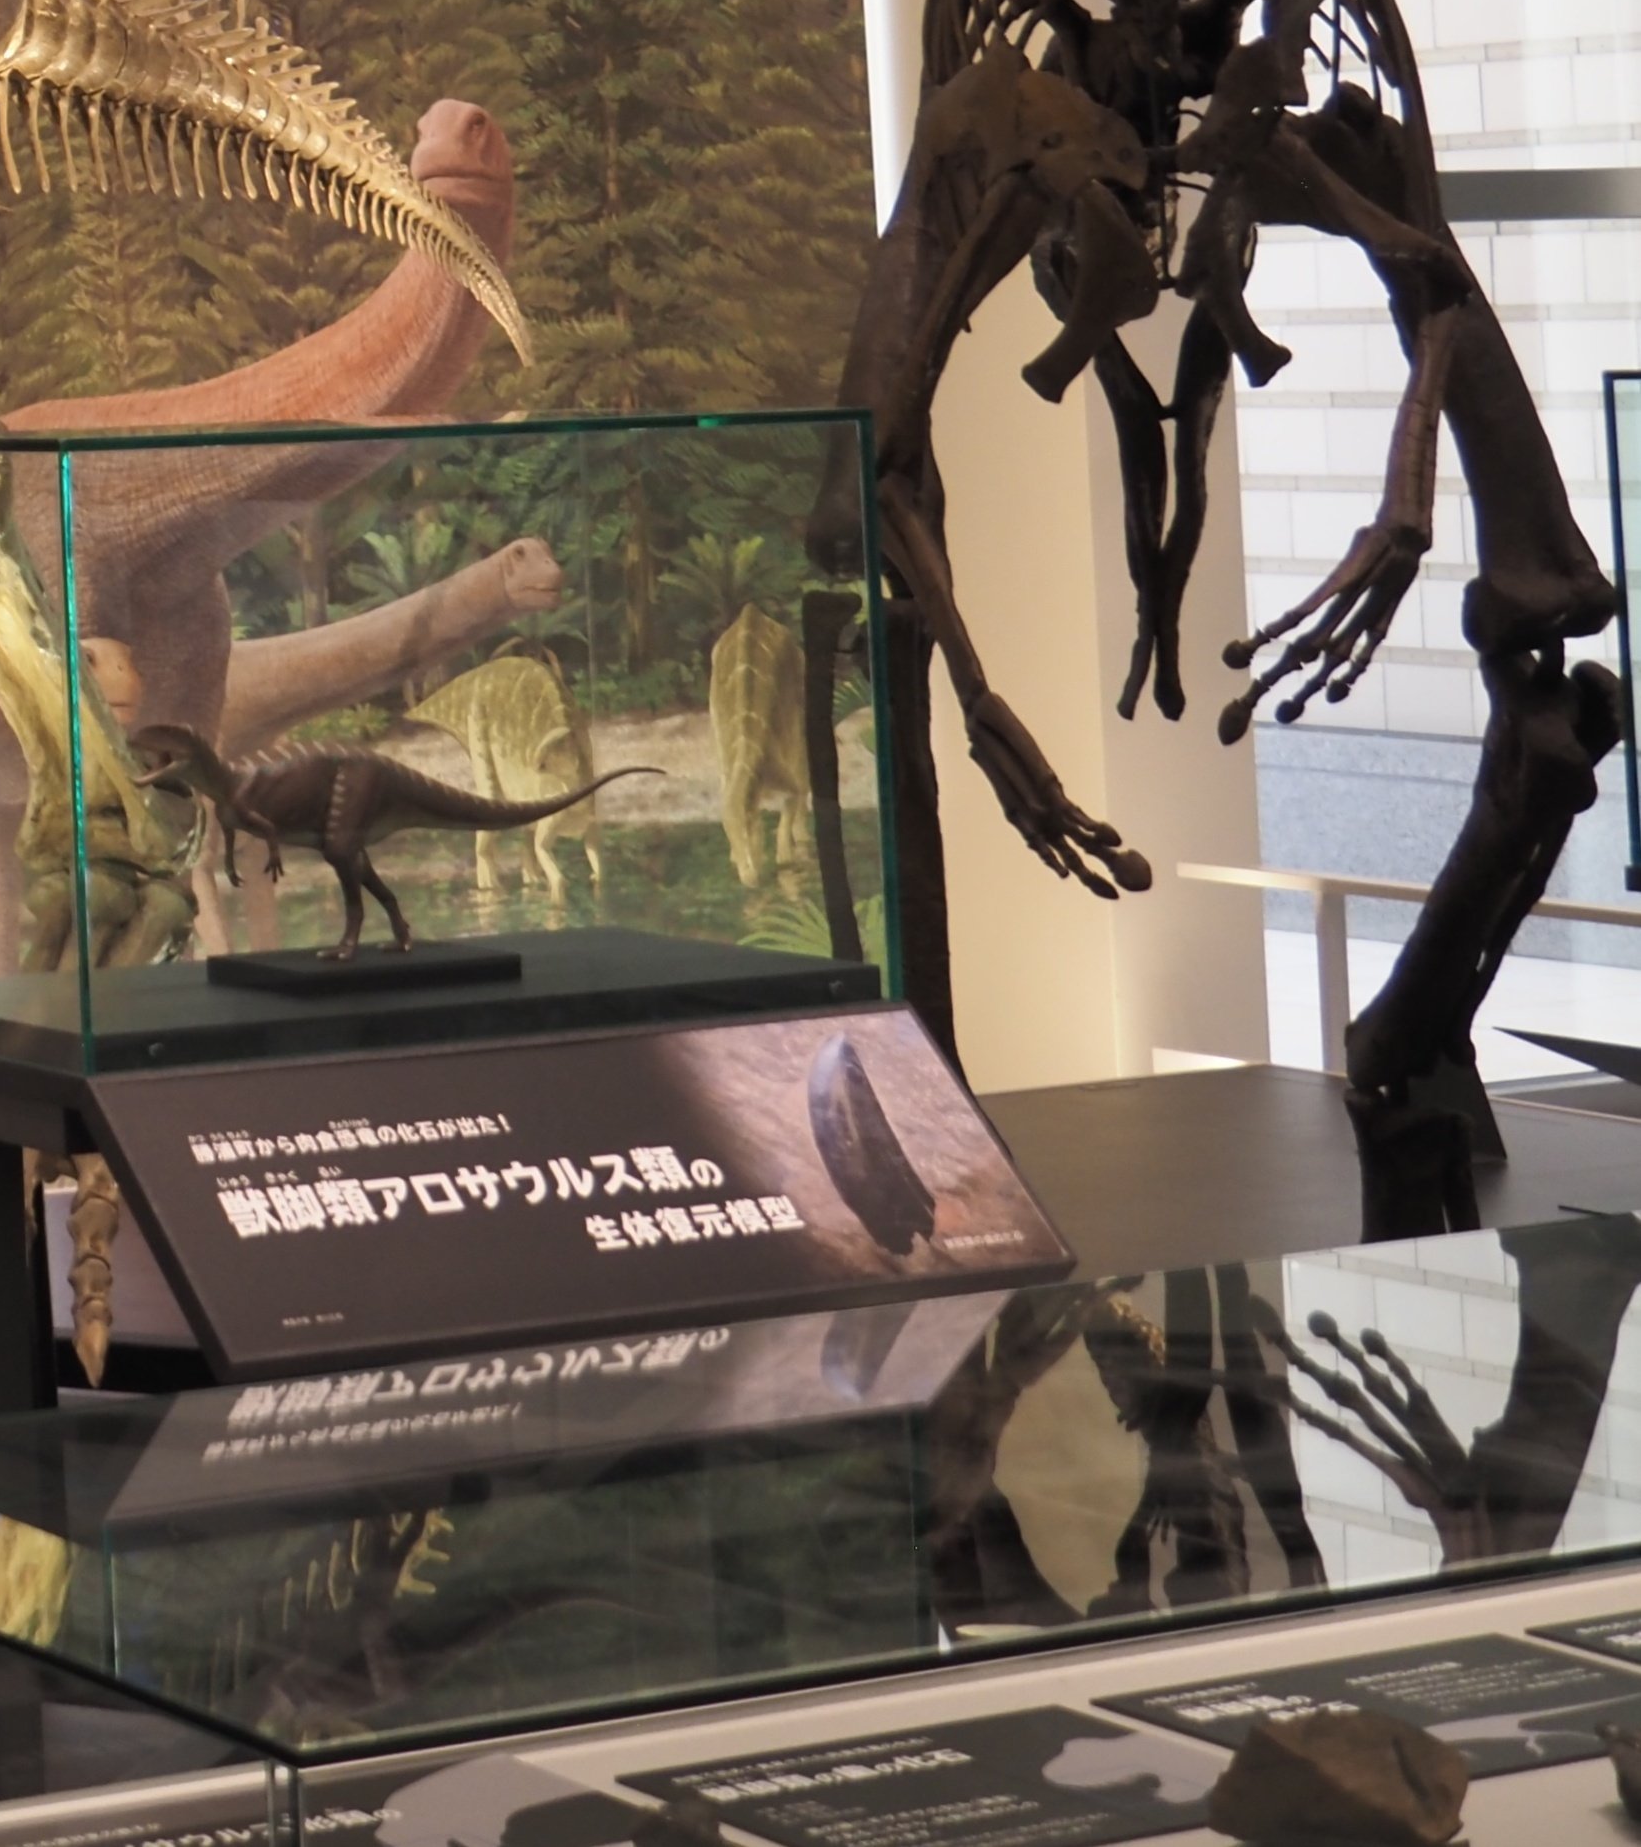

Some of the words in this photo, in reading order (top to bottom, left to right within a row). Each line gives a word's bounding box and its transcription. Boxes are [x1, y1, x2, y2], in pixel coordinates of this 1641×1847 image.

[217, 1145, 725, 1239] 獣脚類アロサウルス類の
[585, 1194, 807, 1252] 生体復元模型
